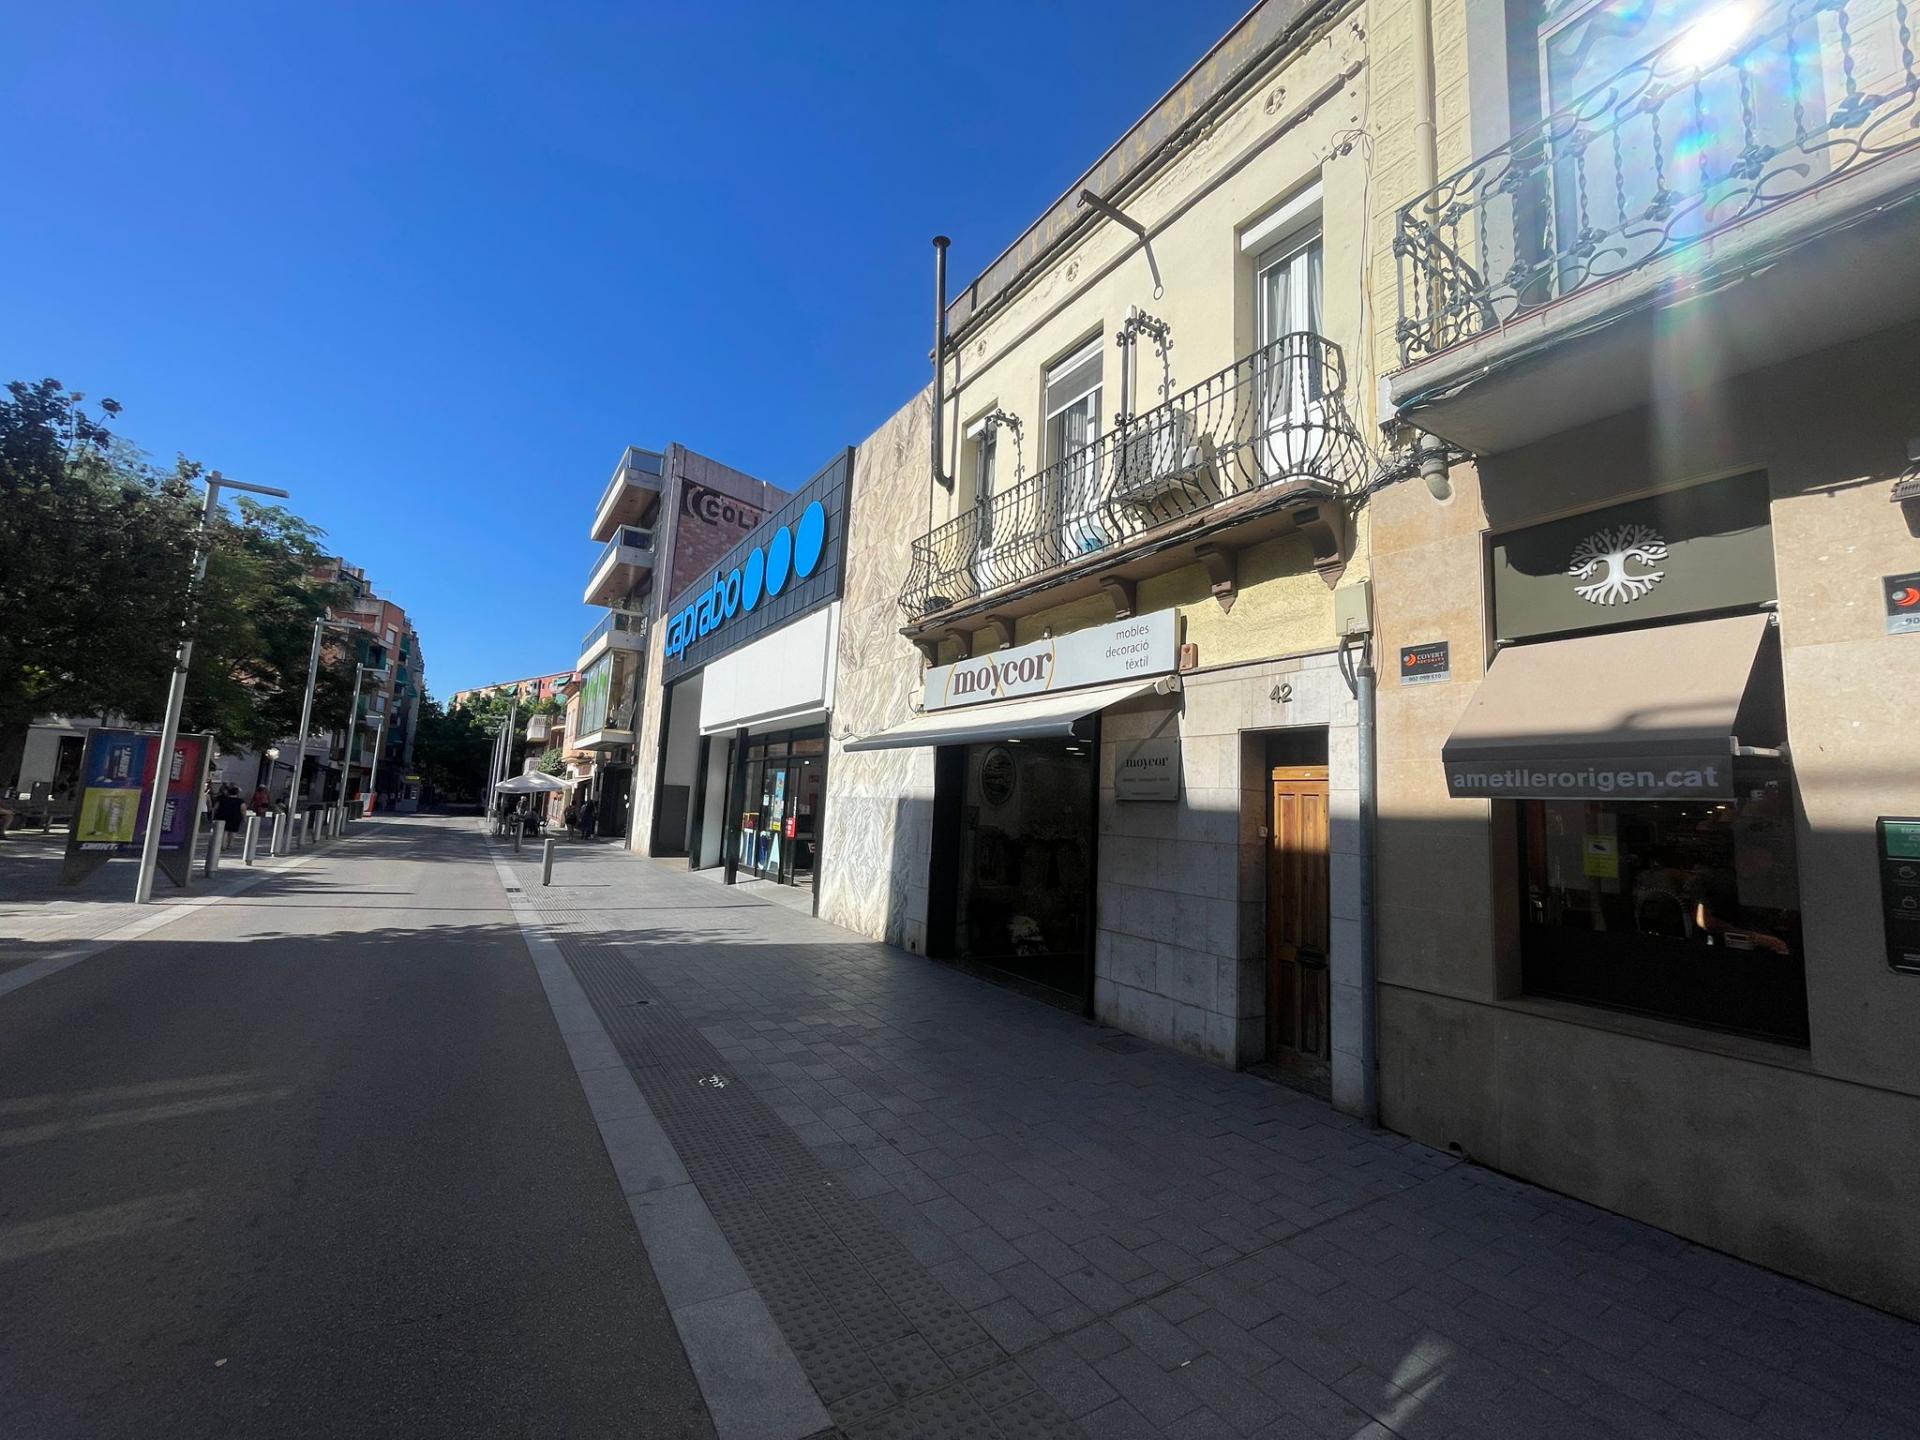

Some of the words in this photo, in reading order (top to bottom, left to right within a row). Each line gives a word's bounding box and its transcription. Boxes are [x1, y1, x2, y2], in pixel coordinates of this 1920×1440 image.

[665, 570, 741, 661] caprabo
[1116, 624, 1150, 640] mobles
[1105, 639, 1150, 658] decoració
[953, 651, 1054, 697] moycor
[1269, 682, 1293, 703] 42
[1126, 757, 1169, 770] moycor
[1453, 766, 1720, 791] ametllerorigen.cat
